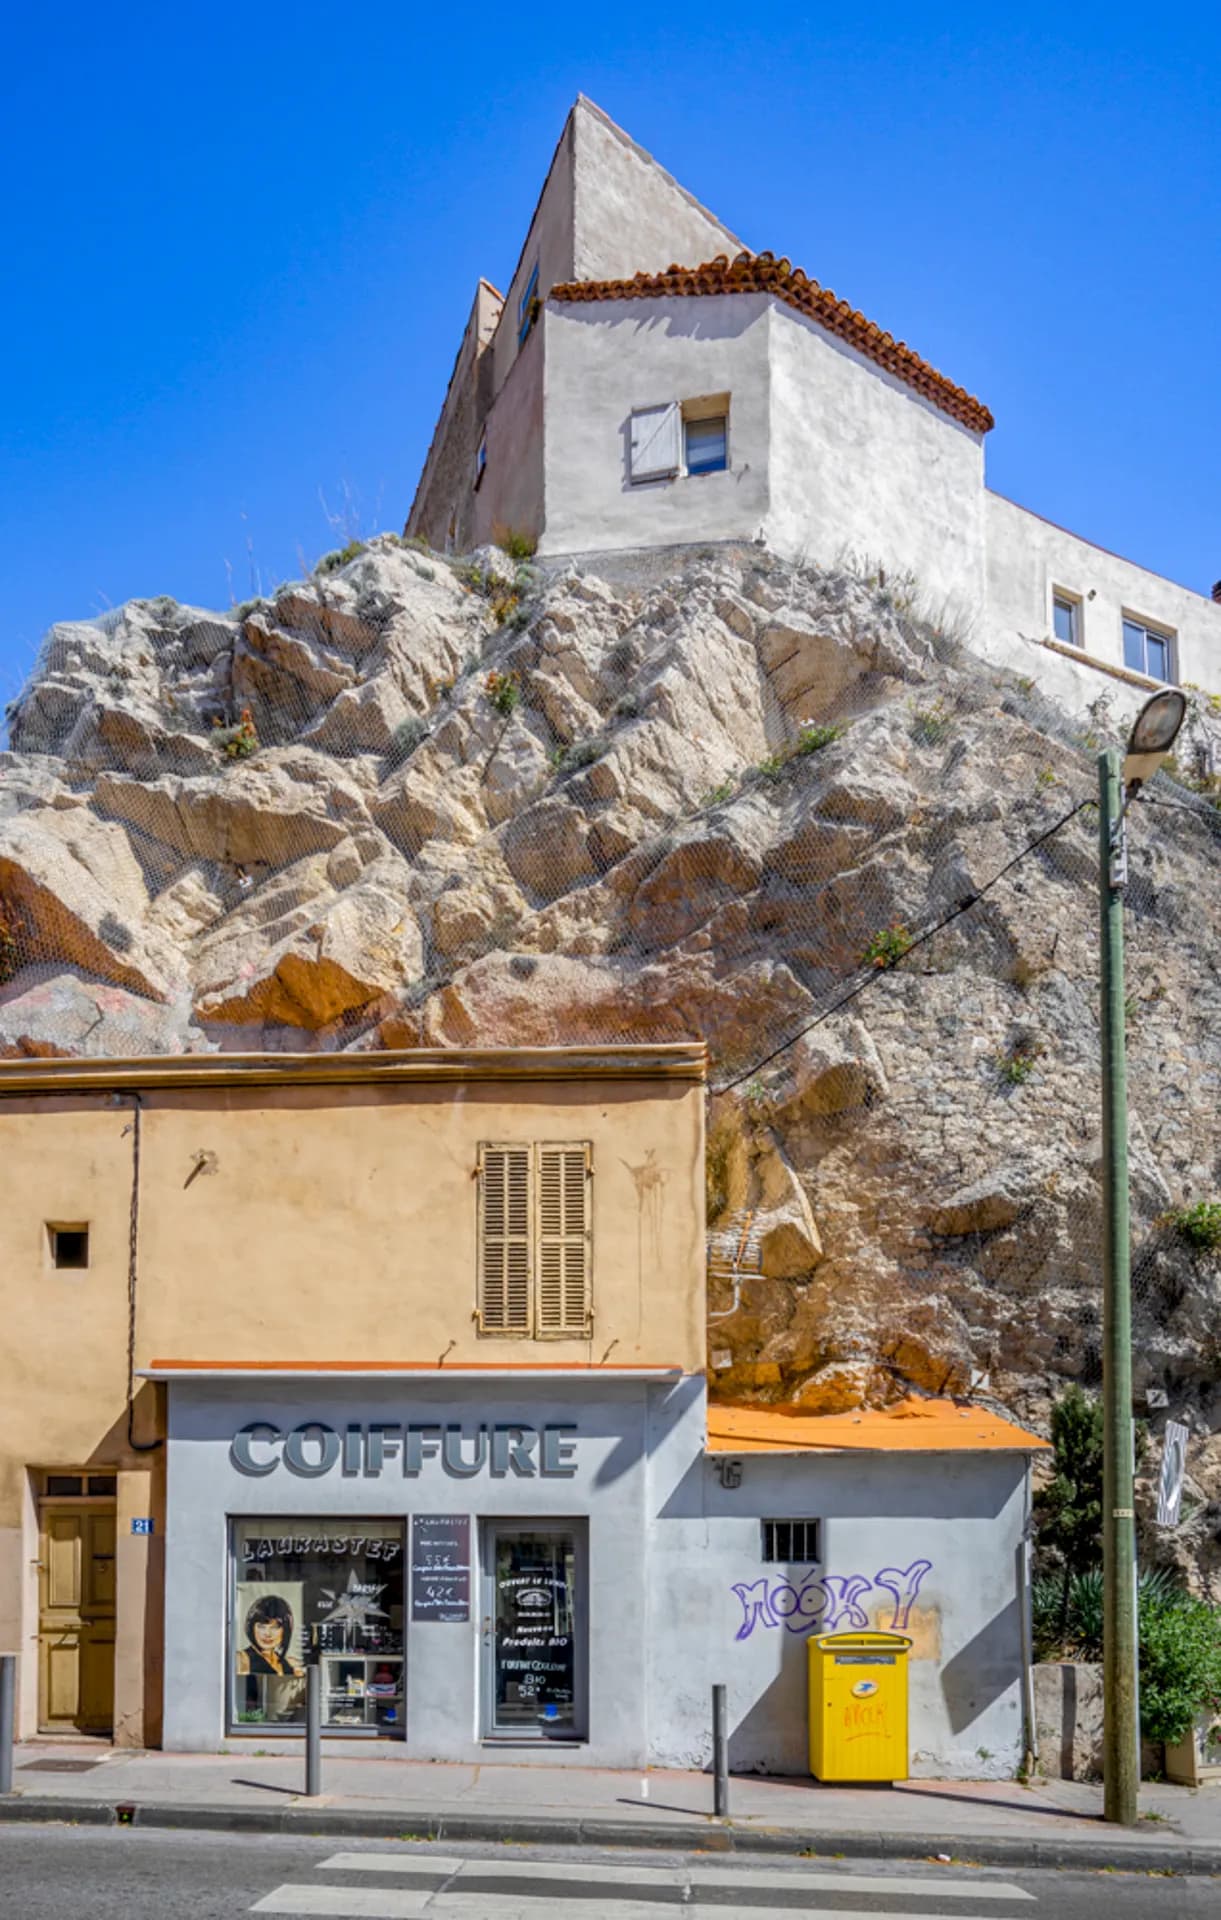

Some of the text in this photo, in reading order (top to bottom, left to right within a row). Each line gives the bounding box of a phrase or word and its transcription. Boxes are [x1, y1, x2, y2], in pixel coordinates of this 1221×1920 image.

[230, 1422, 578, 1476] COIFFURE
[135, 1519, 149, 1532] 21
[242, 1535, 400, 1562] LAURASTEF
[502, 1637, 568, 1647] Produits BIO
